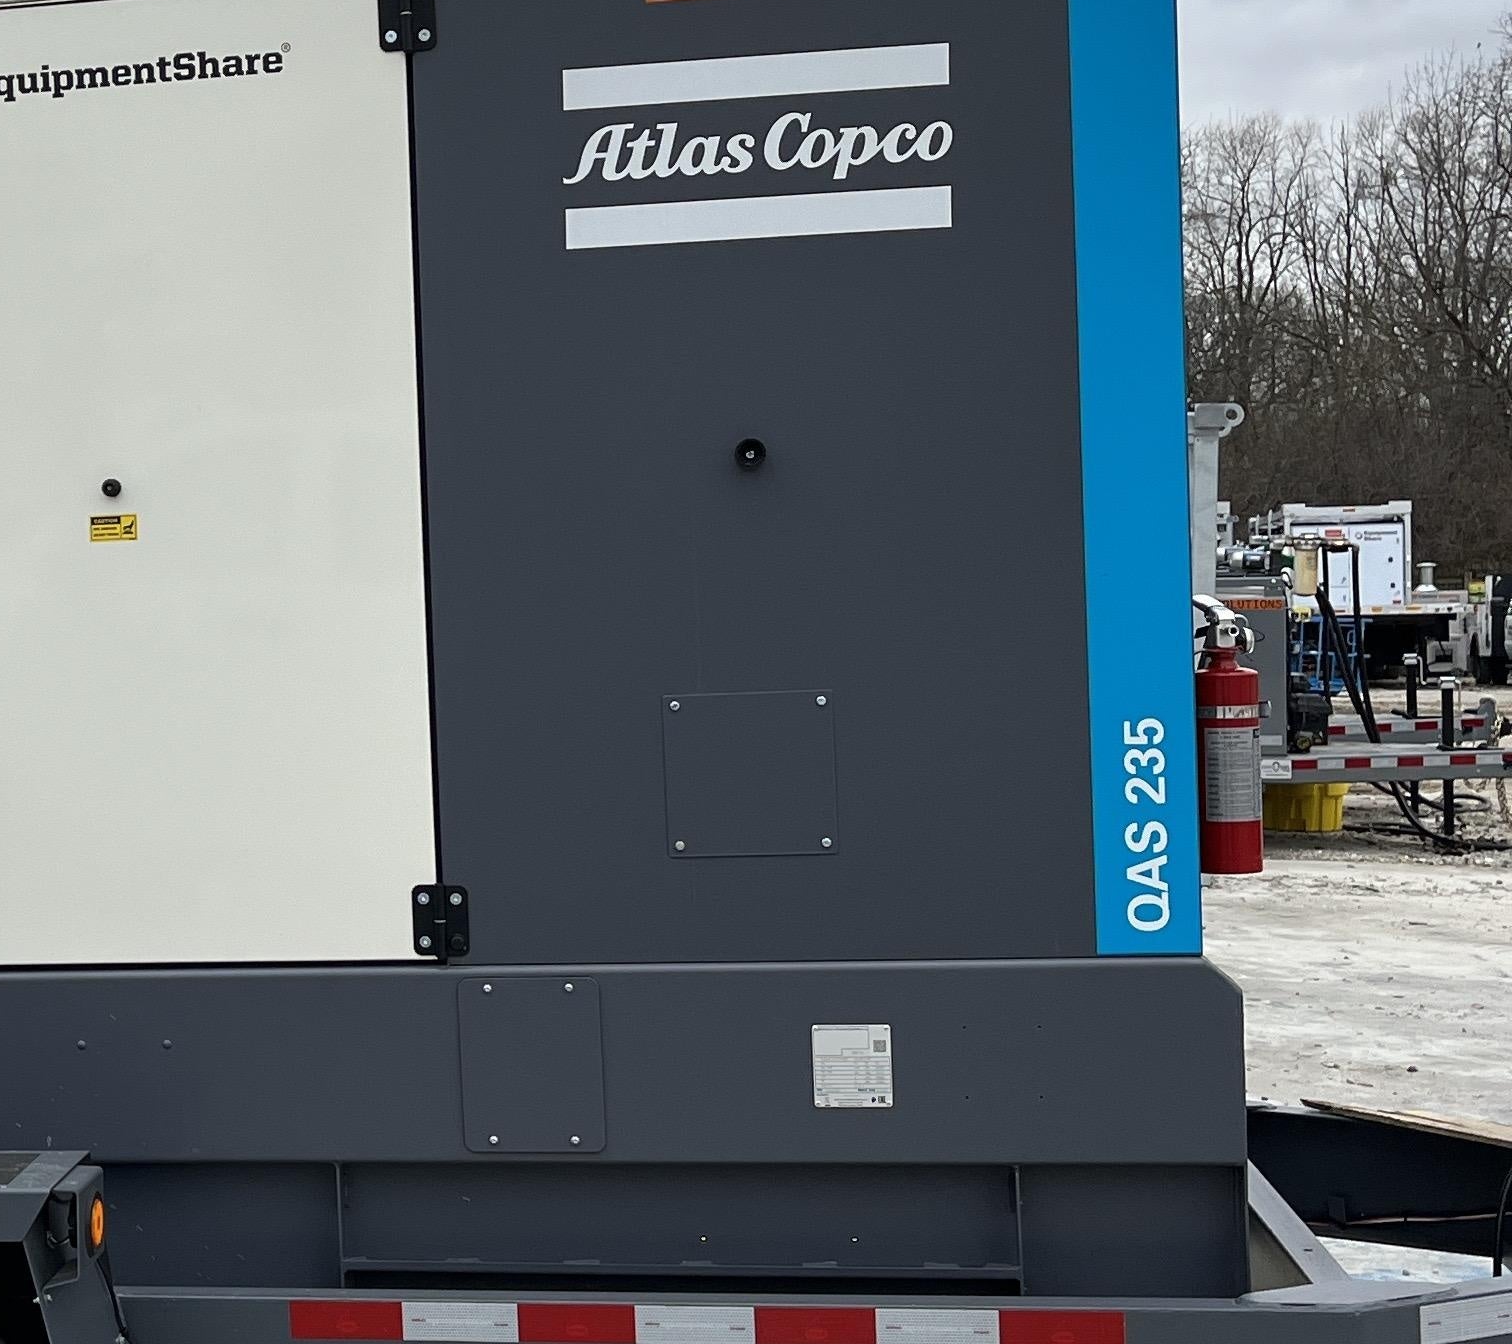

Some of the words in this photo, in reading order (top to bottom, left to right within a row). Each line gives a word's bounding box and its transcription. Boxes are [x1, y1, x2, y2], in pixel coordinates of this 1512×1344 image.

[562, 120, 756, 185] Atlas
[763, 112, 954, 180] Copco
[1123, 717, 1167, 805] 235
[1123, 820, 1171, 932] QAS
